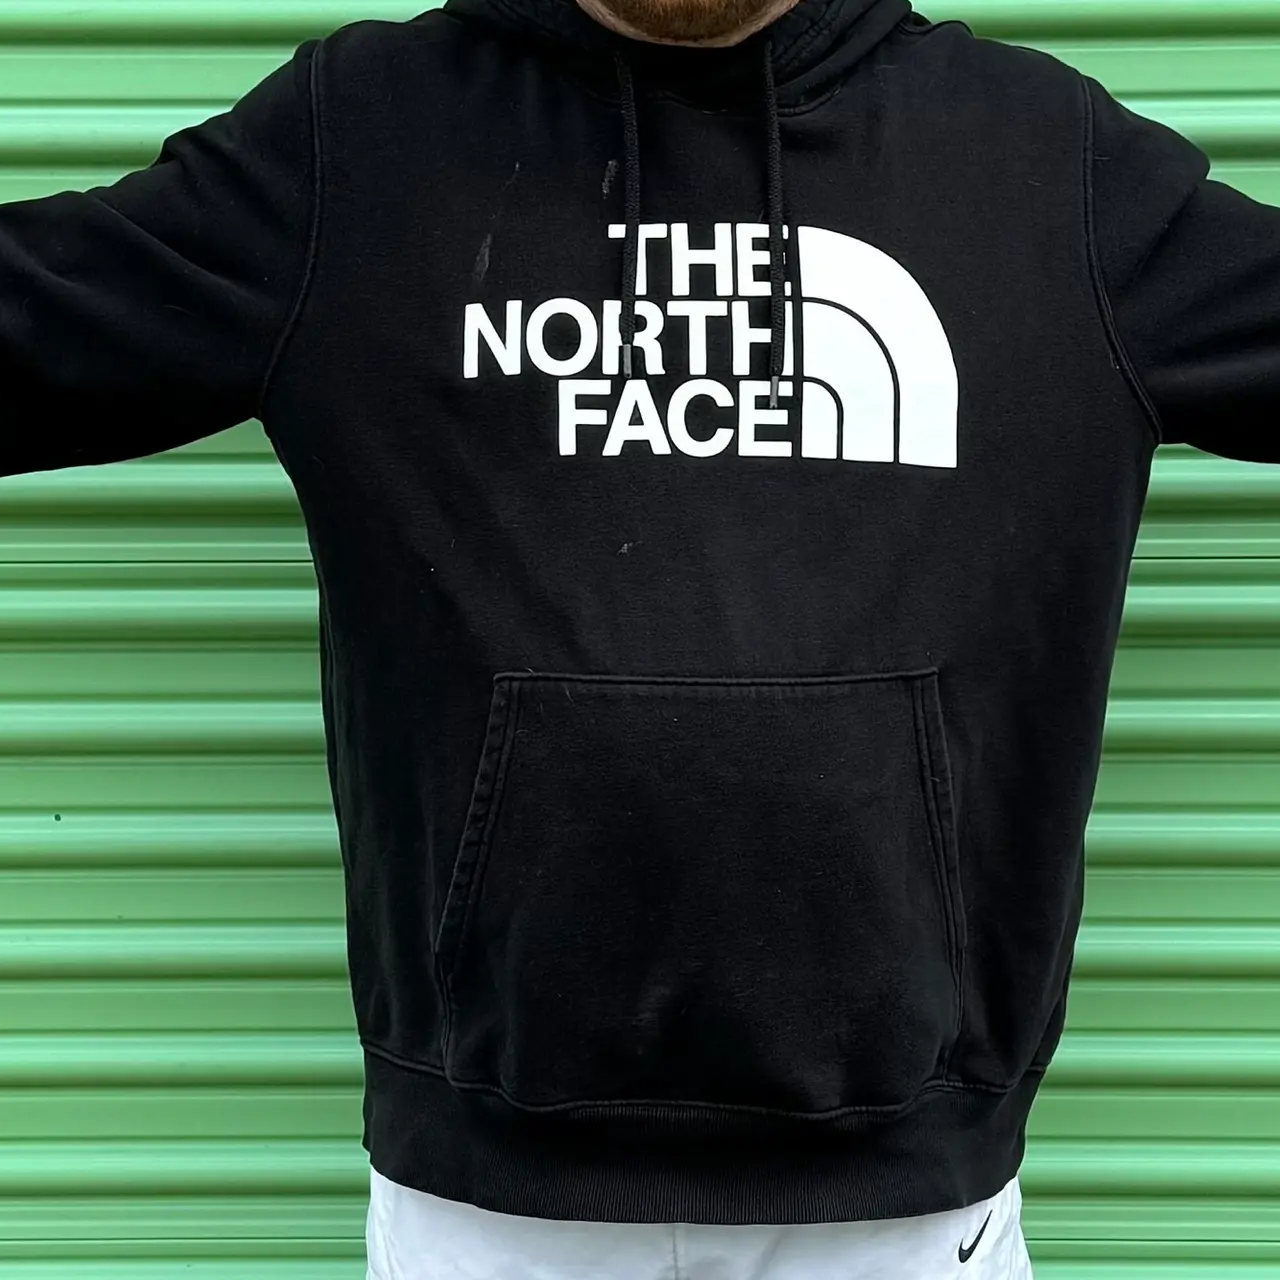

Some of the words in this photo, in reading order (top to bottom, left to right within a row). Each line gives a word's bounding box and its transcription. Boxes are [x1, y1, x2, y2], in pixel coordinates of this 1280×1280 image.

[608, 222, 792, 297] THE
[462, 297, 794, 379] NORTH
[557, 378, 793, 458] FACE
